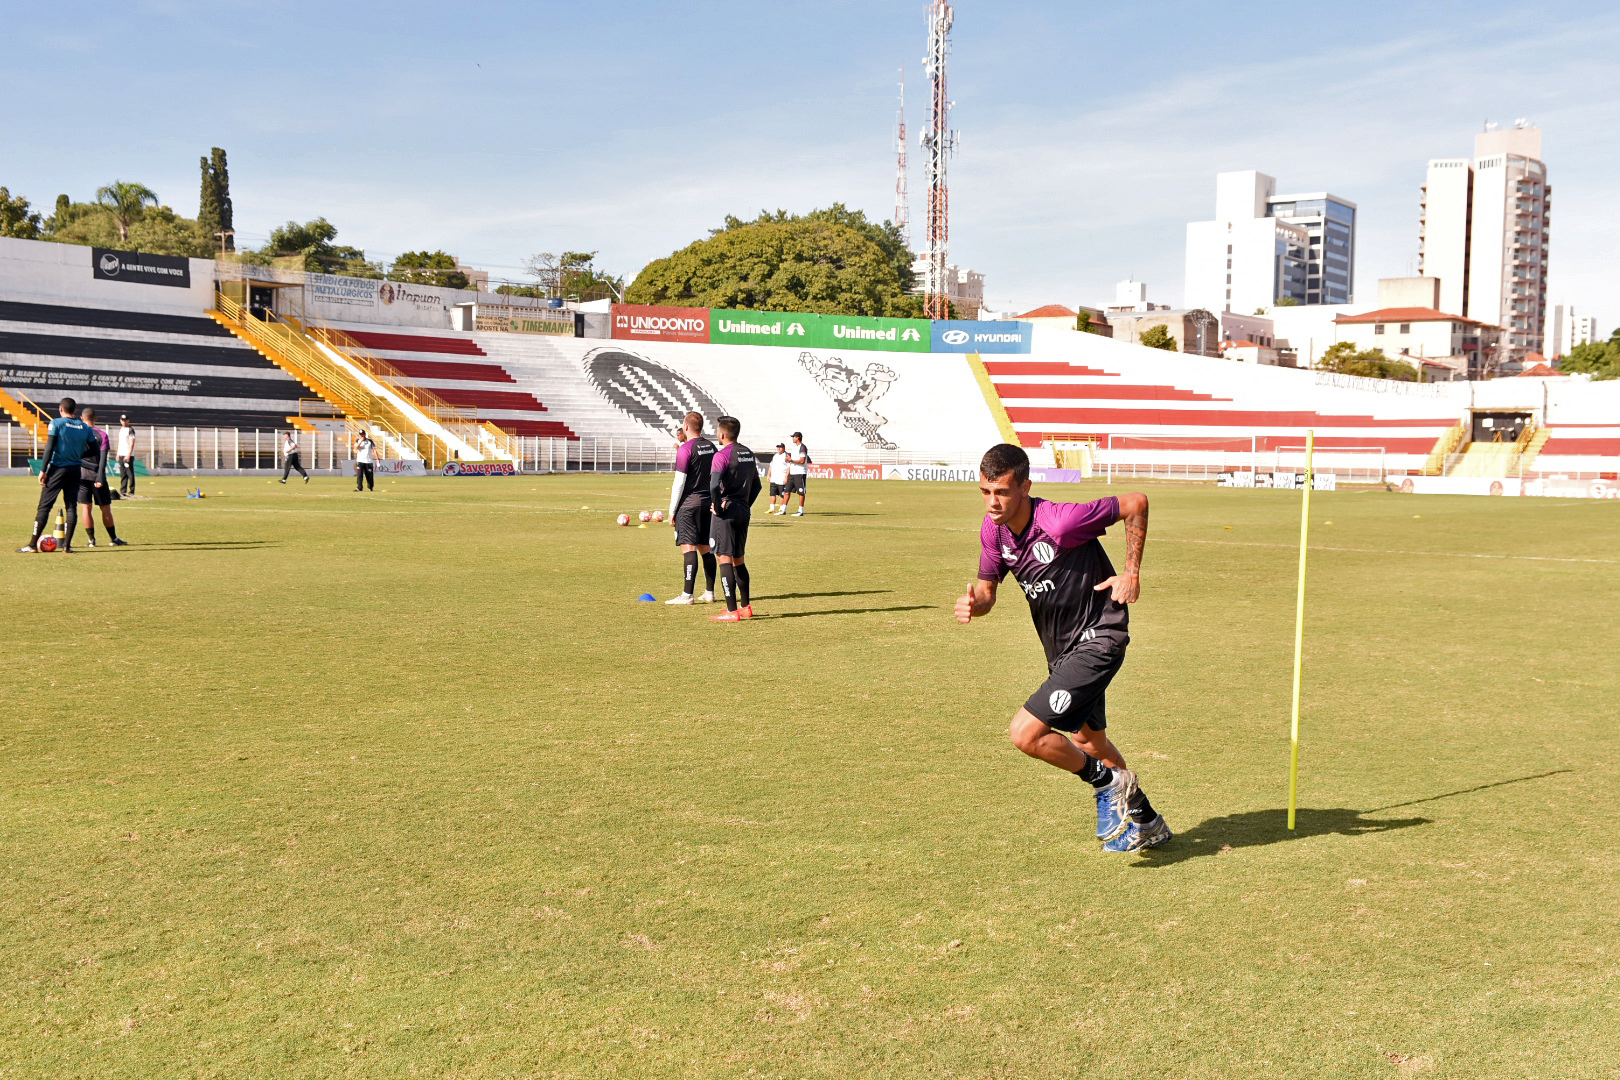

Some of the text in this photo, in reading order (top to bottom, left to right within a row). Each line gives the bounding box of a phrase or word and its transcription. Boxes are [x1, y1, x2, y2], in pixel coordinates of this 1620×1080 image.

[360, 280, 375, 290] DOS
[522, 320, 574, 333] TIMEMANIA
[630, 316, 704, 332] UNIODONTO
[718, 320, 781, 335] Unimed
[833, 325, 896, 340] Unimed
[975, 334, 1021, 343] HYUNDAI
[460, 462, 514, 475] Savegnago
[908, 468, 975, 481] SEGURALTA
